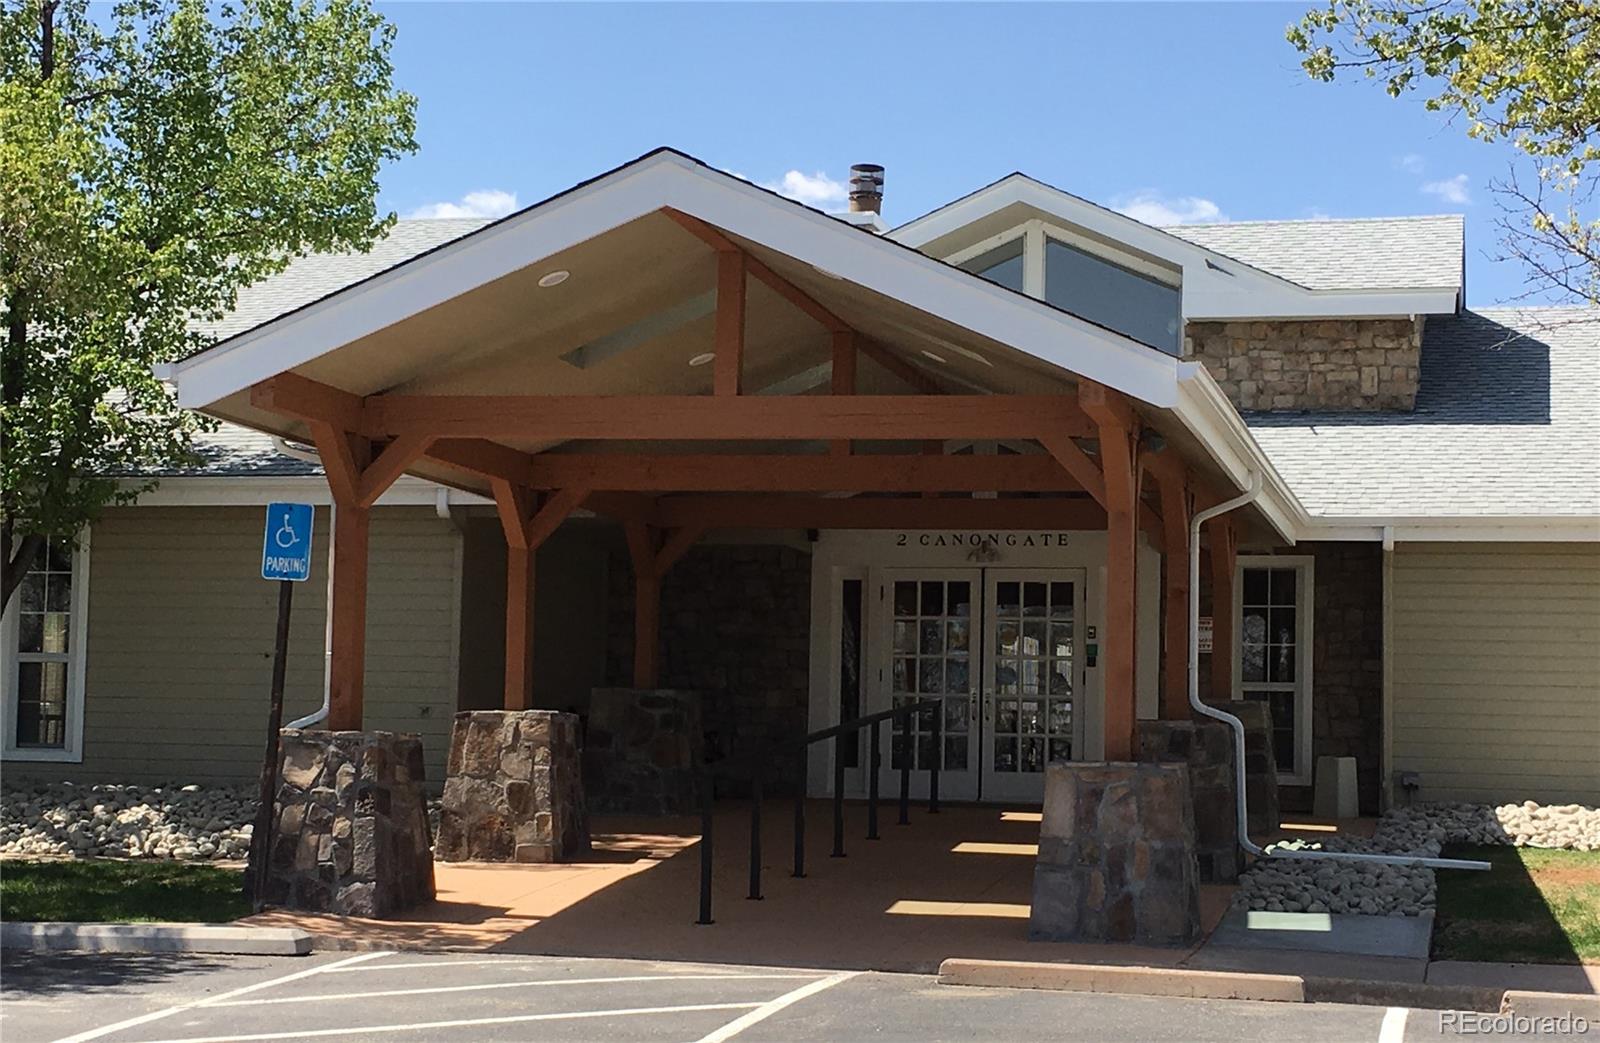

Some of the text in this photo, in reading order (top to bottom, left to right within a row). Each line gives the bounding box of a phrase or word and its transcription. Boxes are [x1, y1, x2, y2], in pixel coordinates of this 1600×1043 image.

[897, 533, 1069, 546] 2 CANONGATE
[265, 556, 306, 573] PARKING
